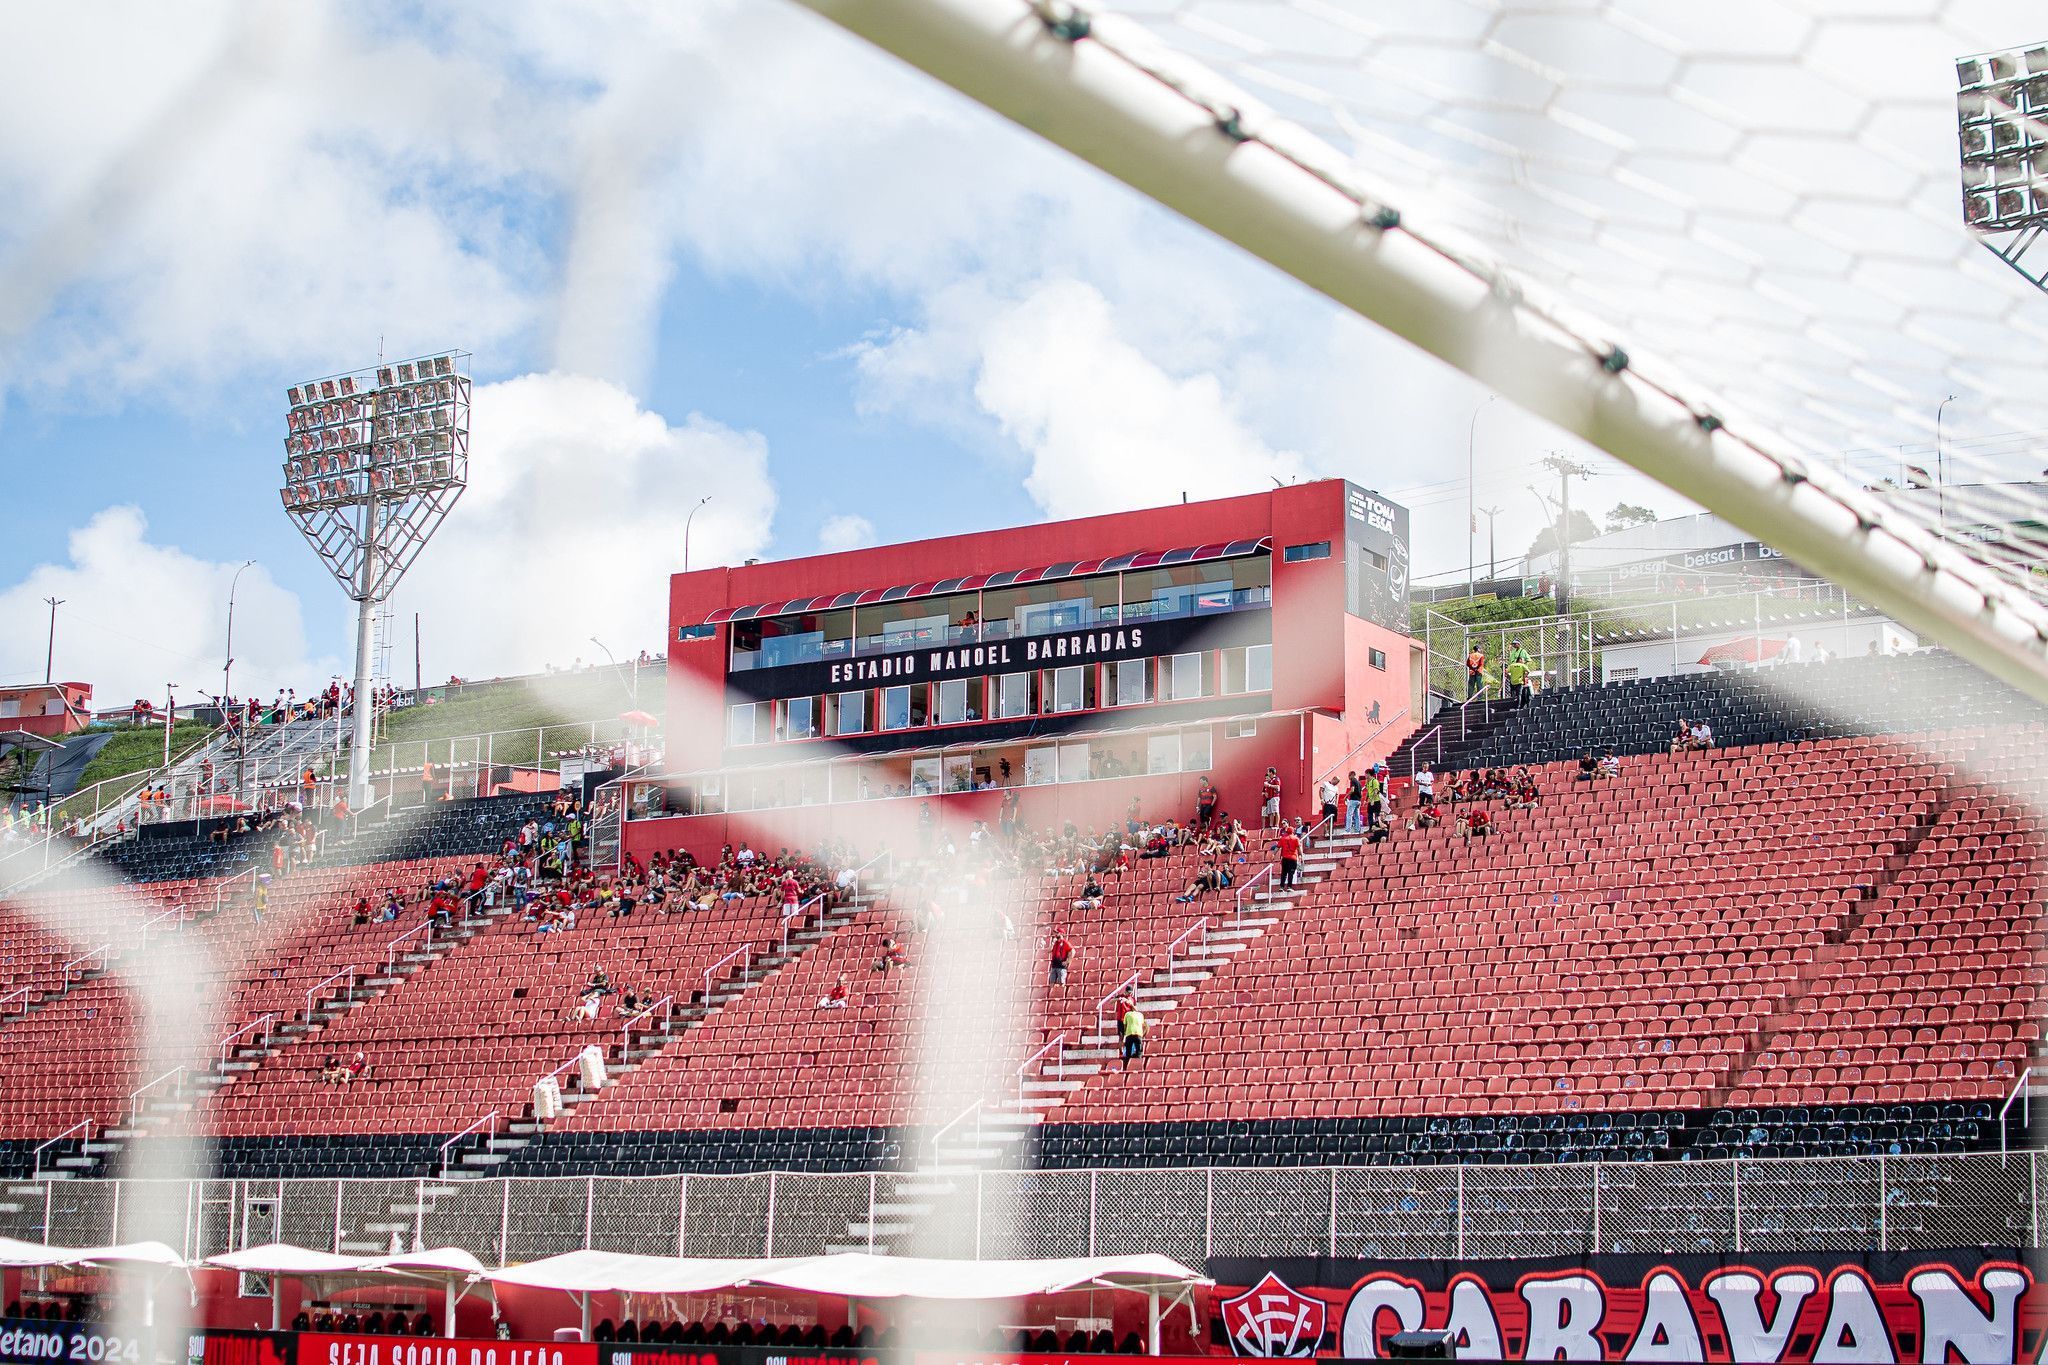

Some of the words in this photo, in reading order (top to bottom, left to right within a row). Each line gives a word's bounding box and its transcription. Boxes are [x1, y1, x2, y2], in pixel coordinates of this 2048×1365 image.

[1365, 496, 1396, 522] TOMA
[1368, 511, 1394, 535] ESSA
[1684, 547, 1735, 568] betsat
[831, 655, 915, 683] ESTADIO
[930, 644, 1011, 672] MANOEL
[1027, 628, 1143, 661] BARRADAS
[0, 1326, 62, 1358] etano
[69, 1335, 140, 1362] 2024
[329, 1342, 379, 1365] SEJA
